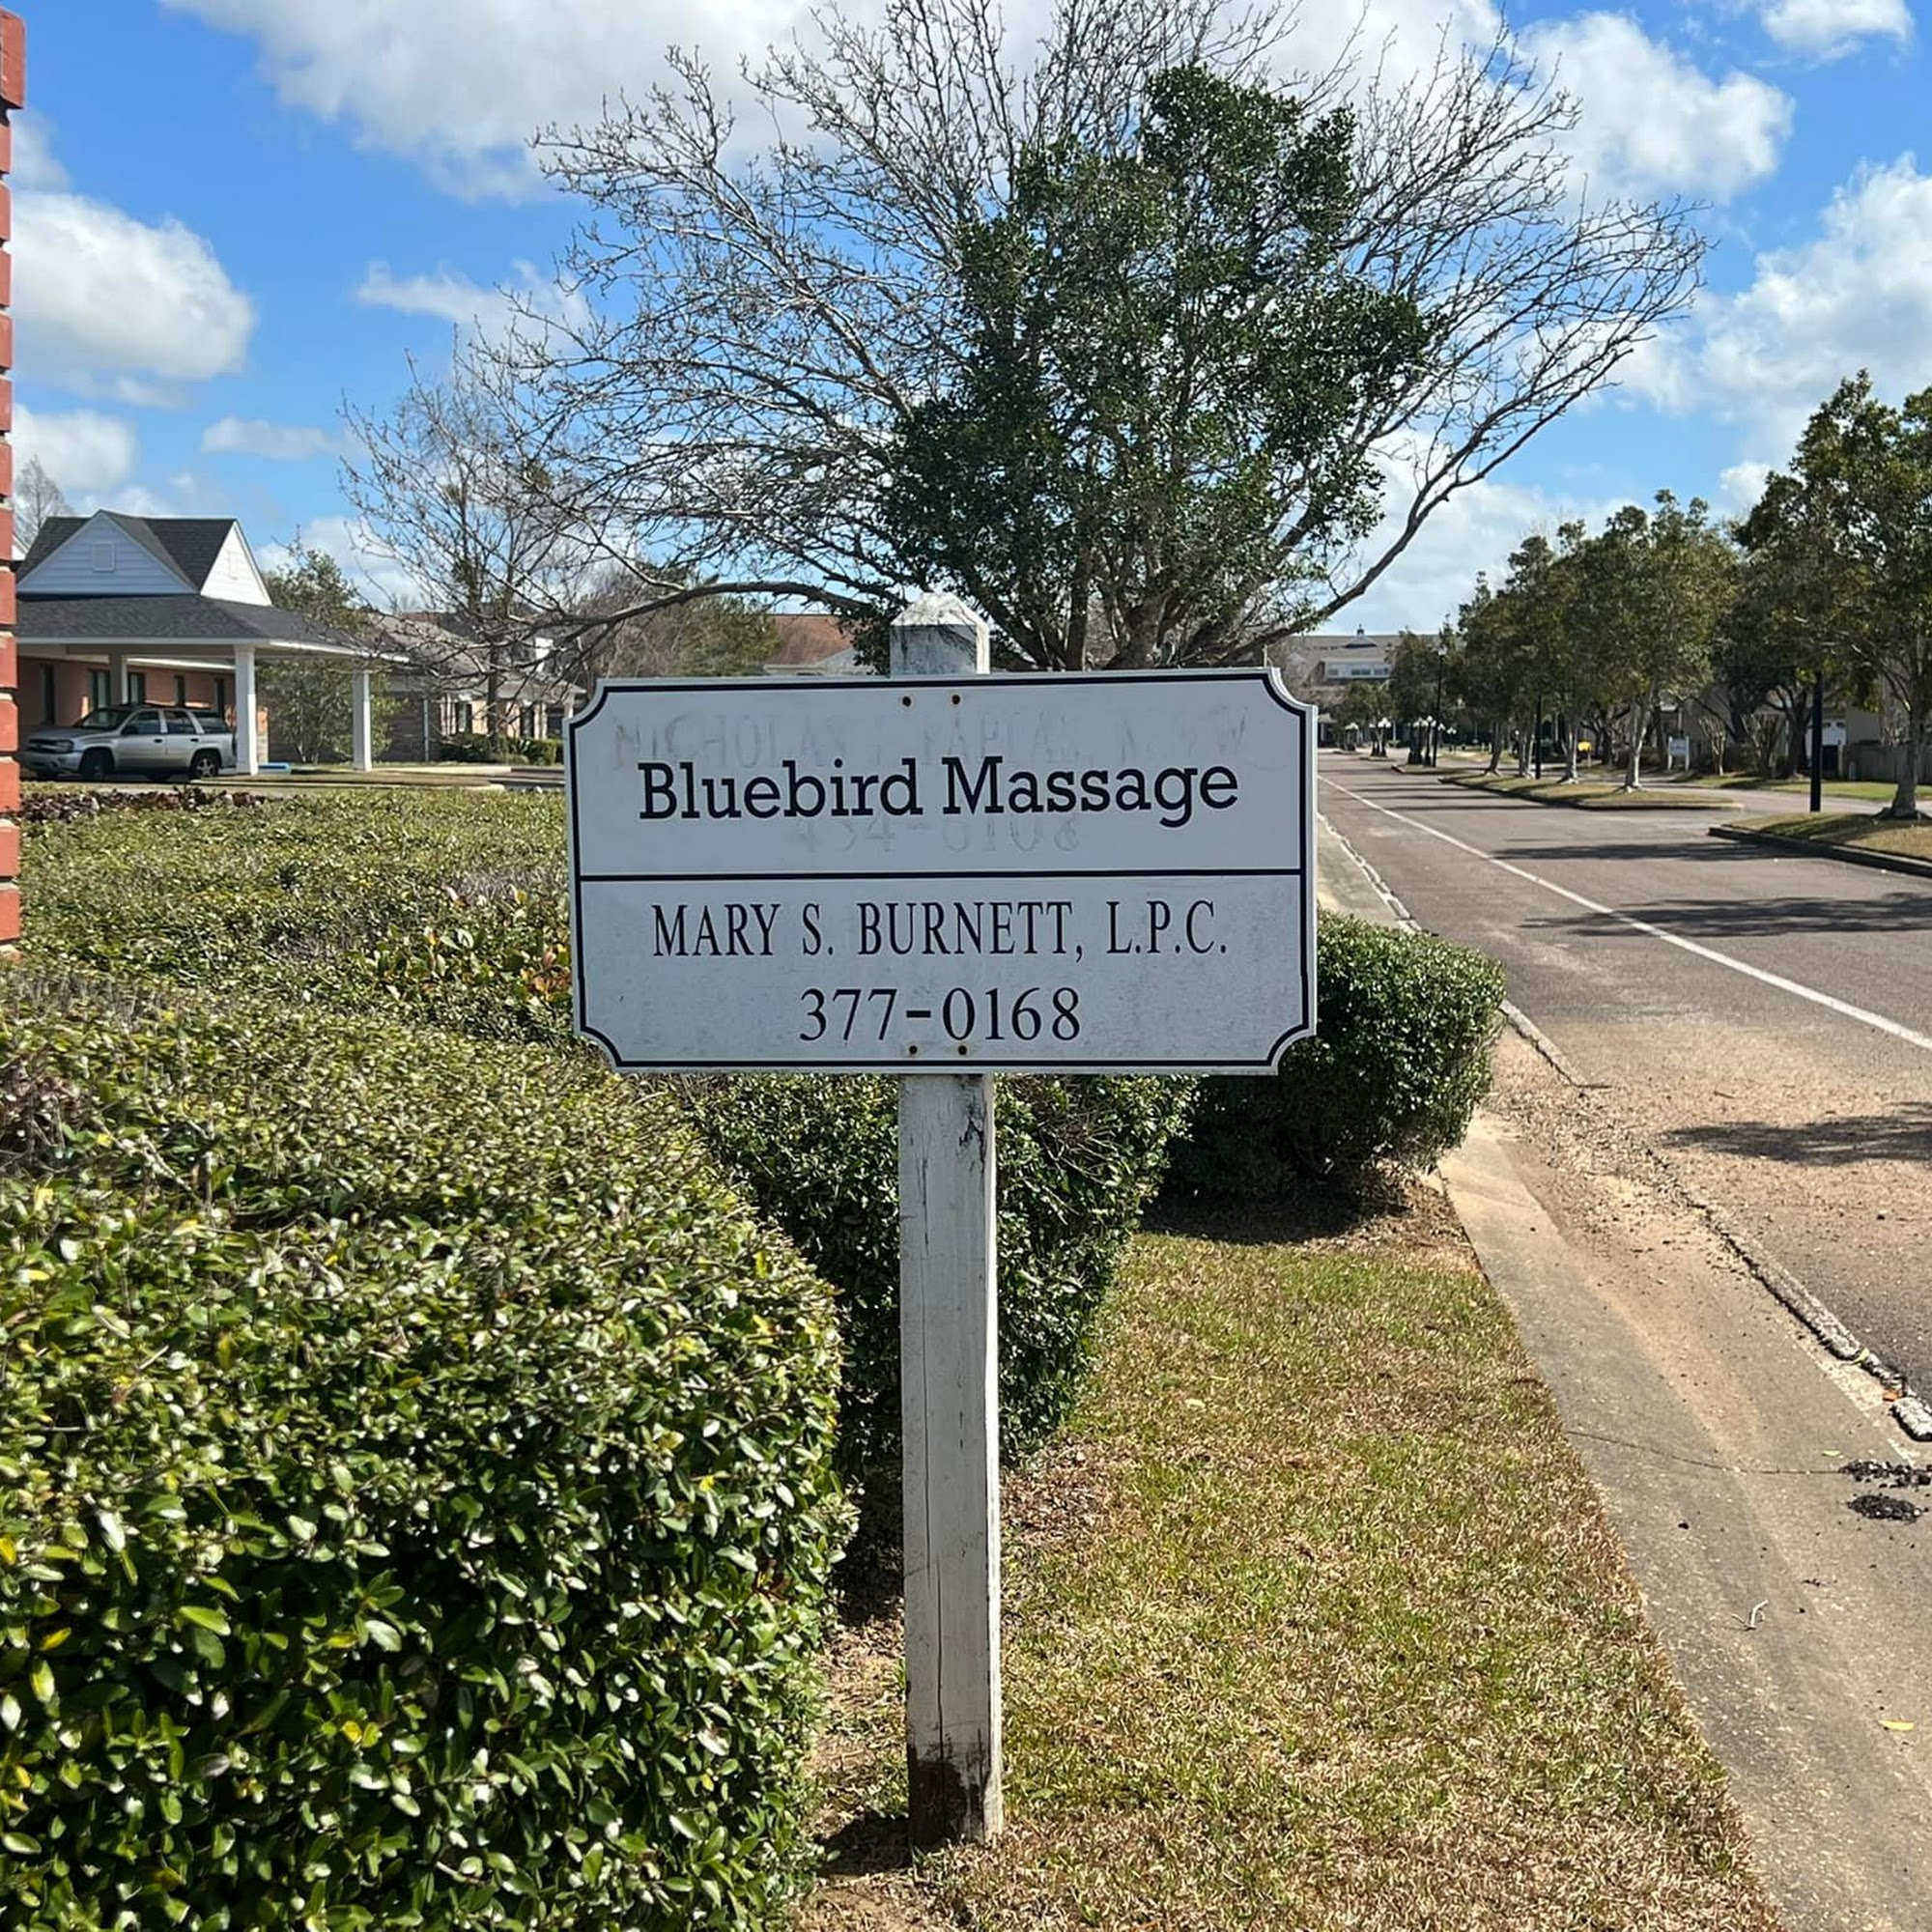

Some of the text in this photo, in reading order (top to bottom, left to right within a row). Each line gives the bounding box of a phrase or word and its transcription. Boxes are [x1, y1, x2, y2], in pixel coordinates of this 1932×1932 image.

[638, 755, 1238, 829] Bluebird Massage
[651, 899, 1228, 963] MARY S. BURNETT, L.P.C.
[800, 986, 1081, 1041] 377-0168
